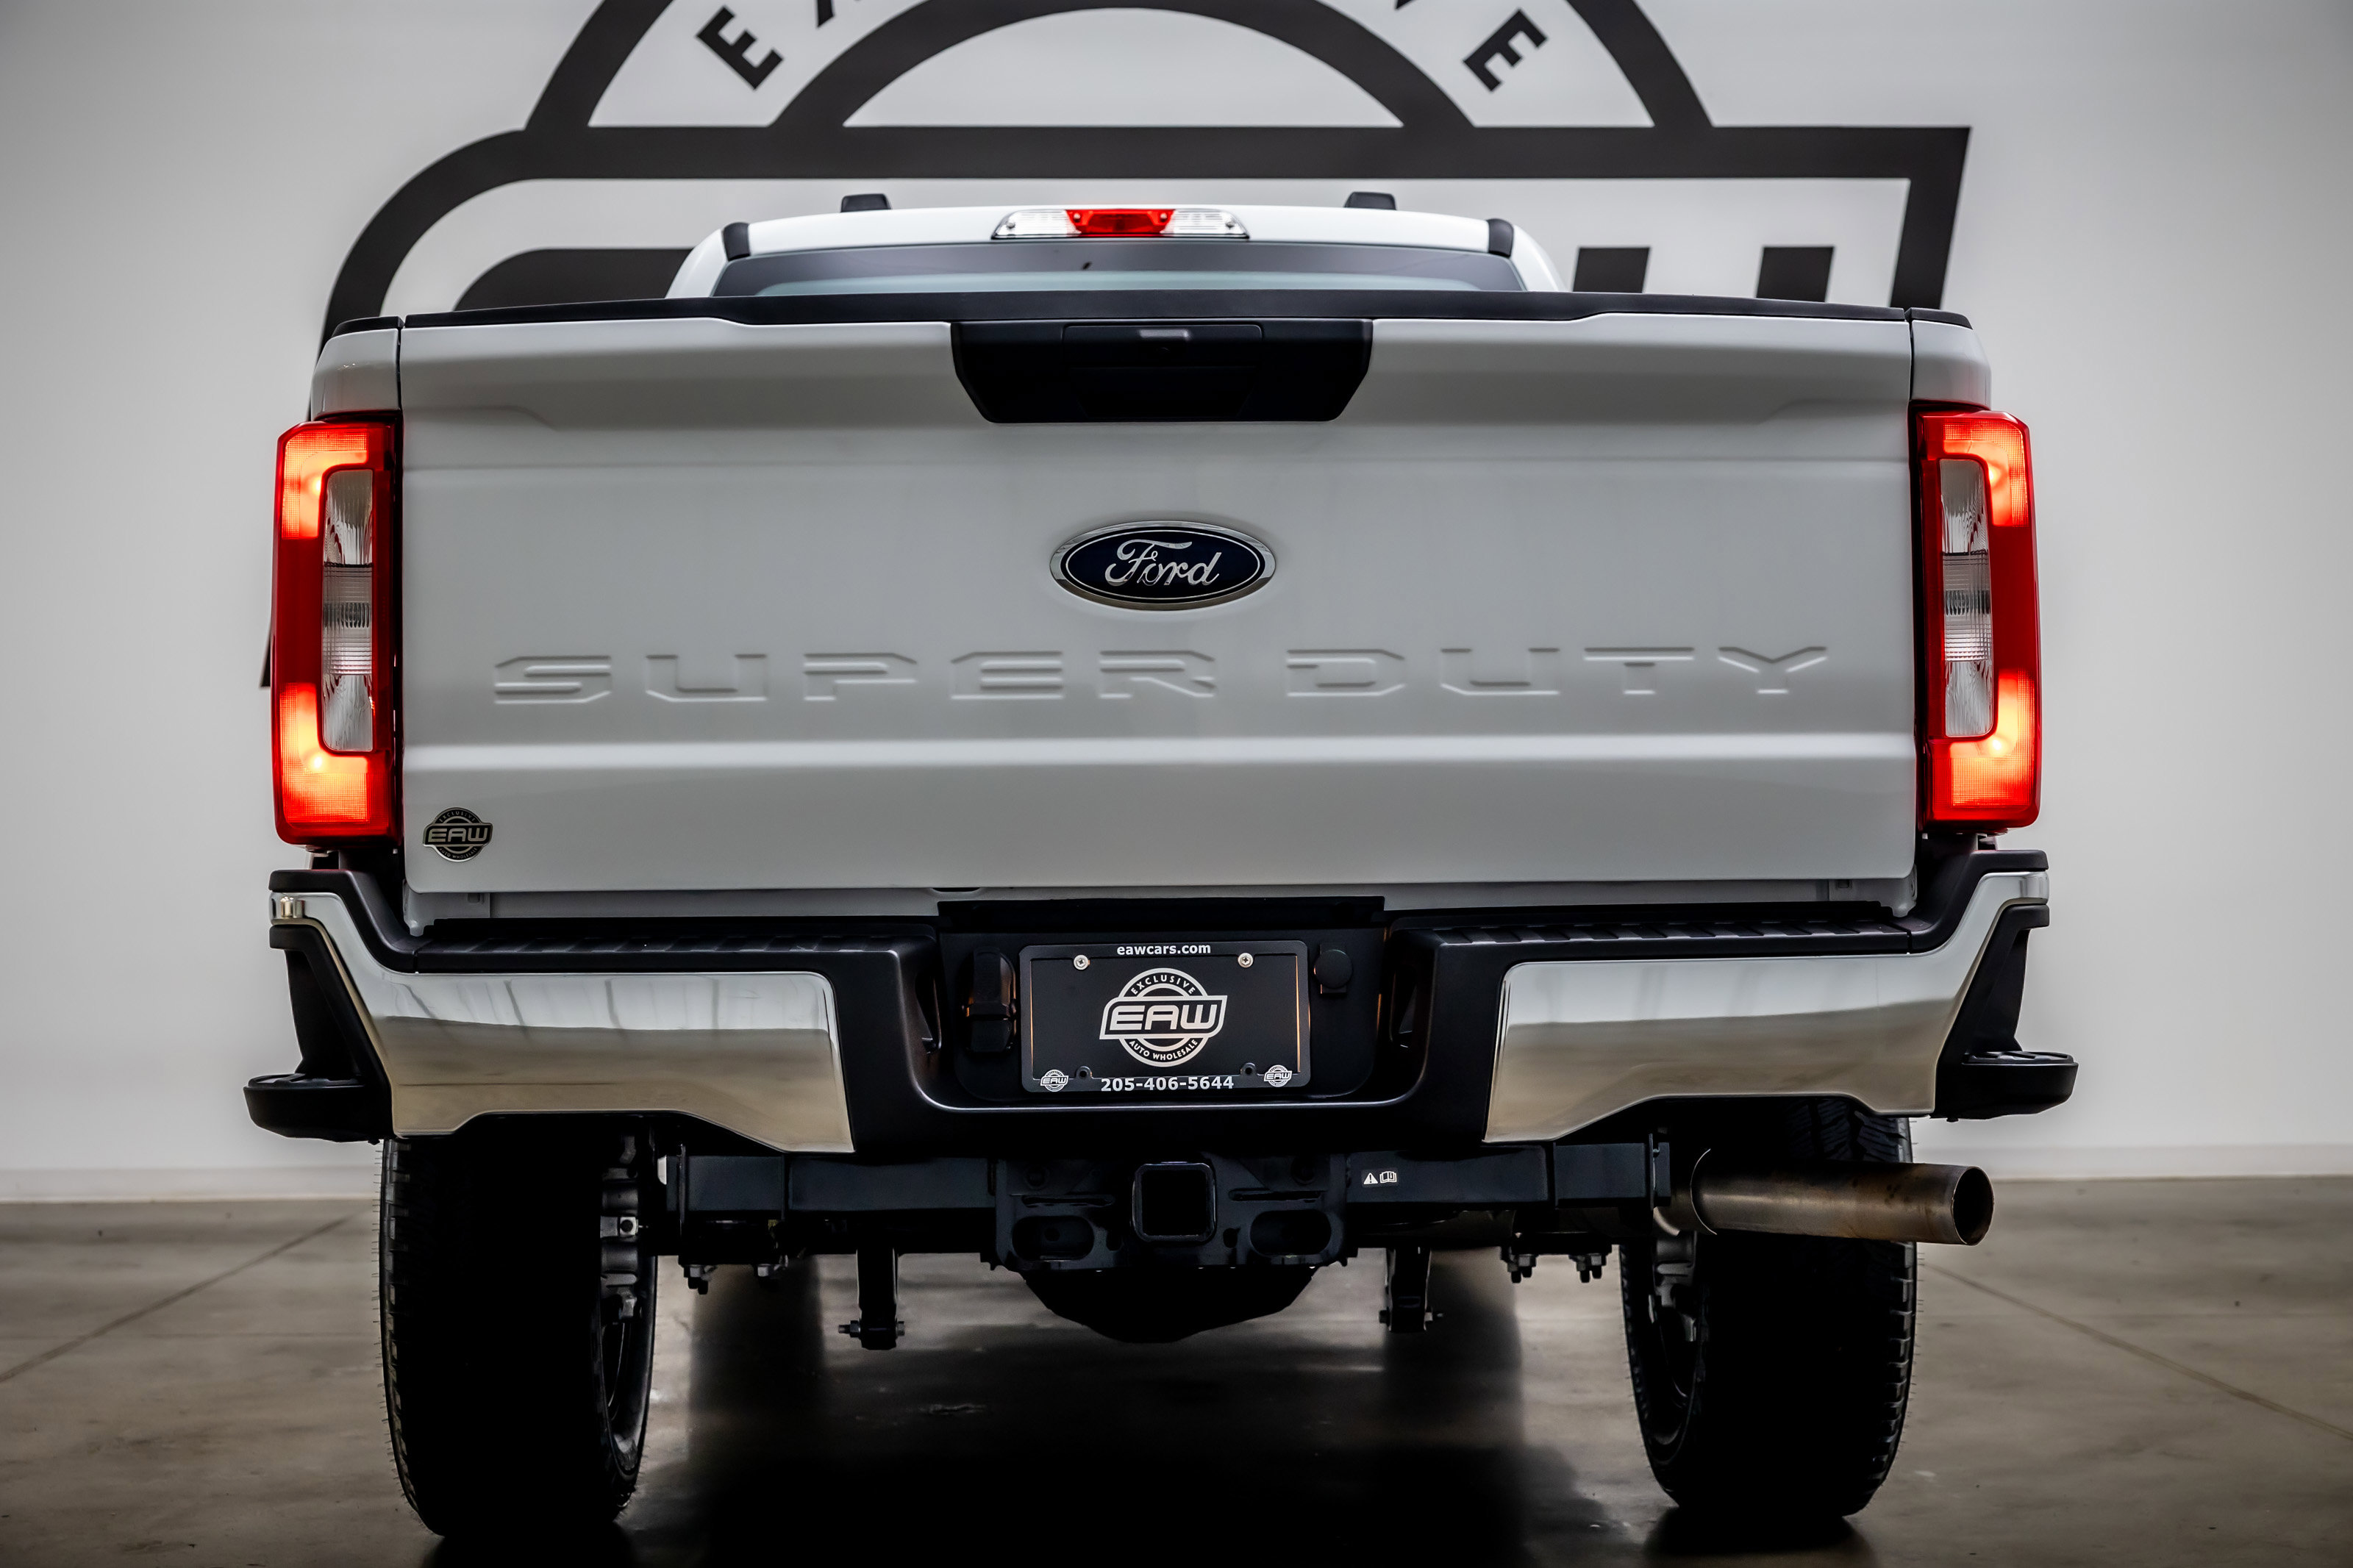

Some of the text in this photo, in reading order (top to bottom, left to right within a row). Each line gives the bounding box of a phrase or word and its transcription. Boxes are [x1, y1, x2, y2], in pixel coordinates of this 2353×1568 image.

[1105, 539, 1221, 586] Ford
[494, 646, 1828, 704] SUPER DUTY
[428, 828, 488, 842] EAW
[1116, 944, 1211, 955] eawcars.com
[1131, 975, 1196, 995] EXCLUSIVE
[1110, 1004, 1218, 1031] EAW
[1129, 1039, 1198, 1061] AUTO WHOLESALE
[1101, 1075, 1235, 1092] 205-406-5644
